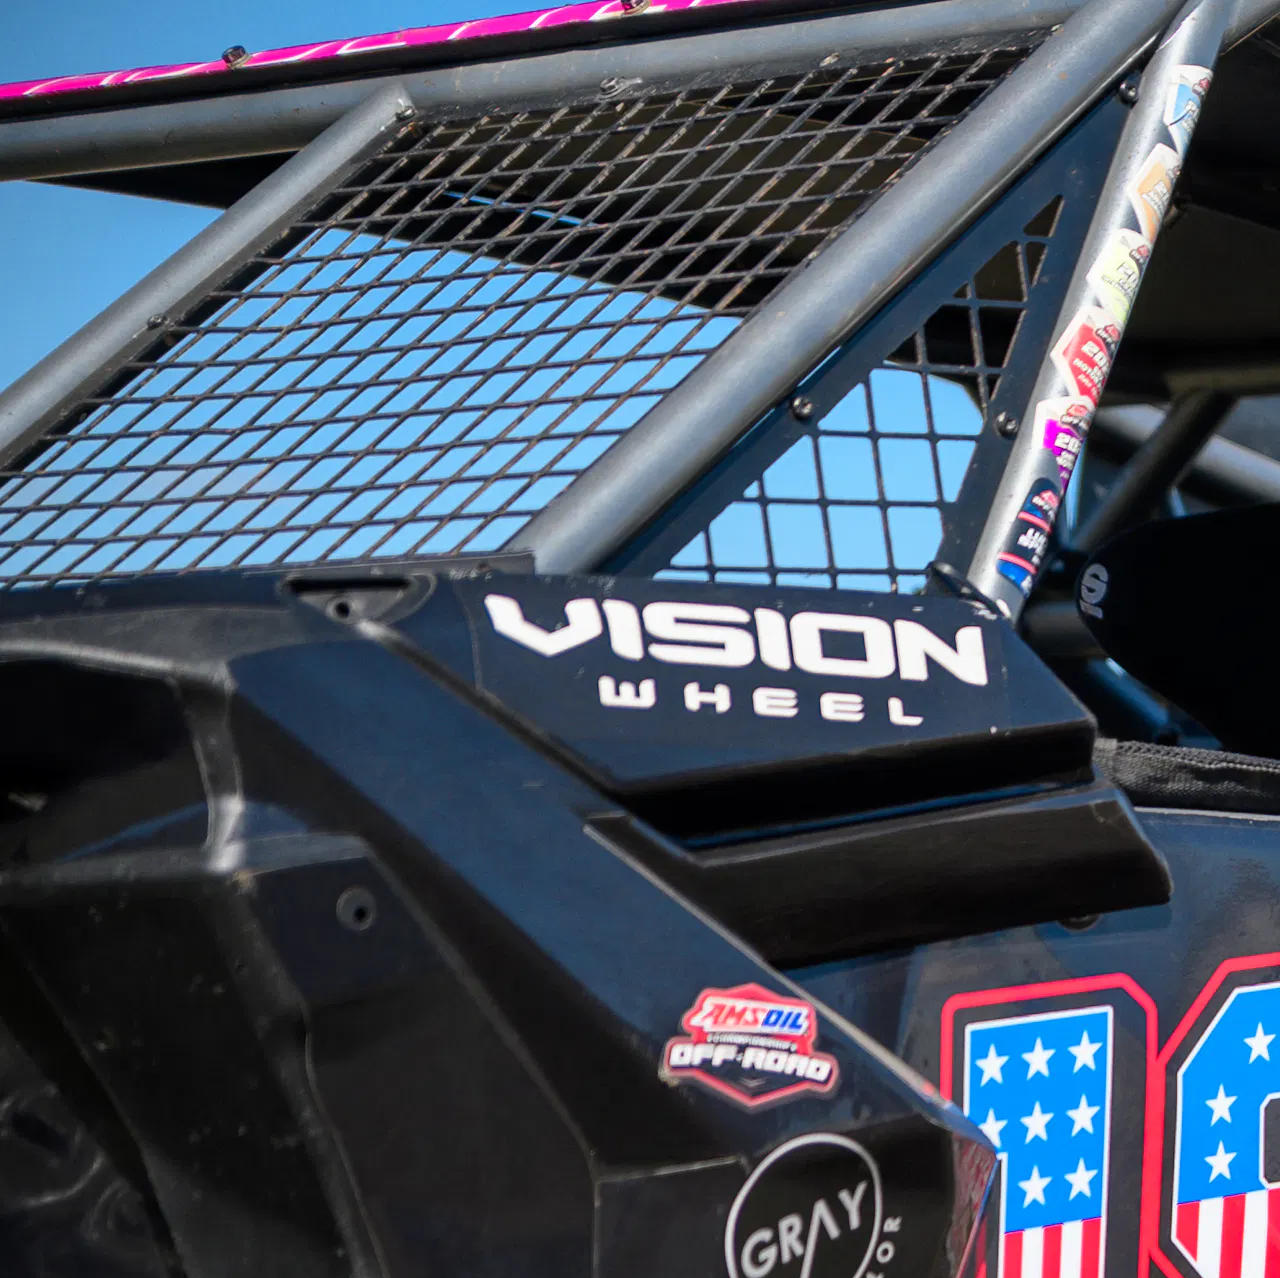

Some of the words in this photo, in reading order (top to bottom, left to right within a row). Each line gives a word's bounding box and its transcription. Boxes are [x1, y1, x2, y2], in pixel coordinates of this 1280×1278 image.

[484, 593, 989, 687] VISION
[597, 675, 924, 727] WHEEL
[692, 998, 809, 1034] AMSOIL
